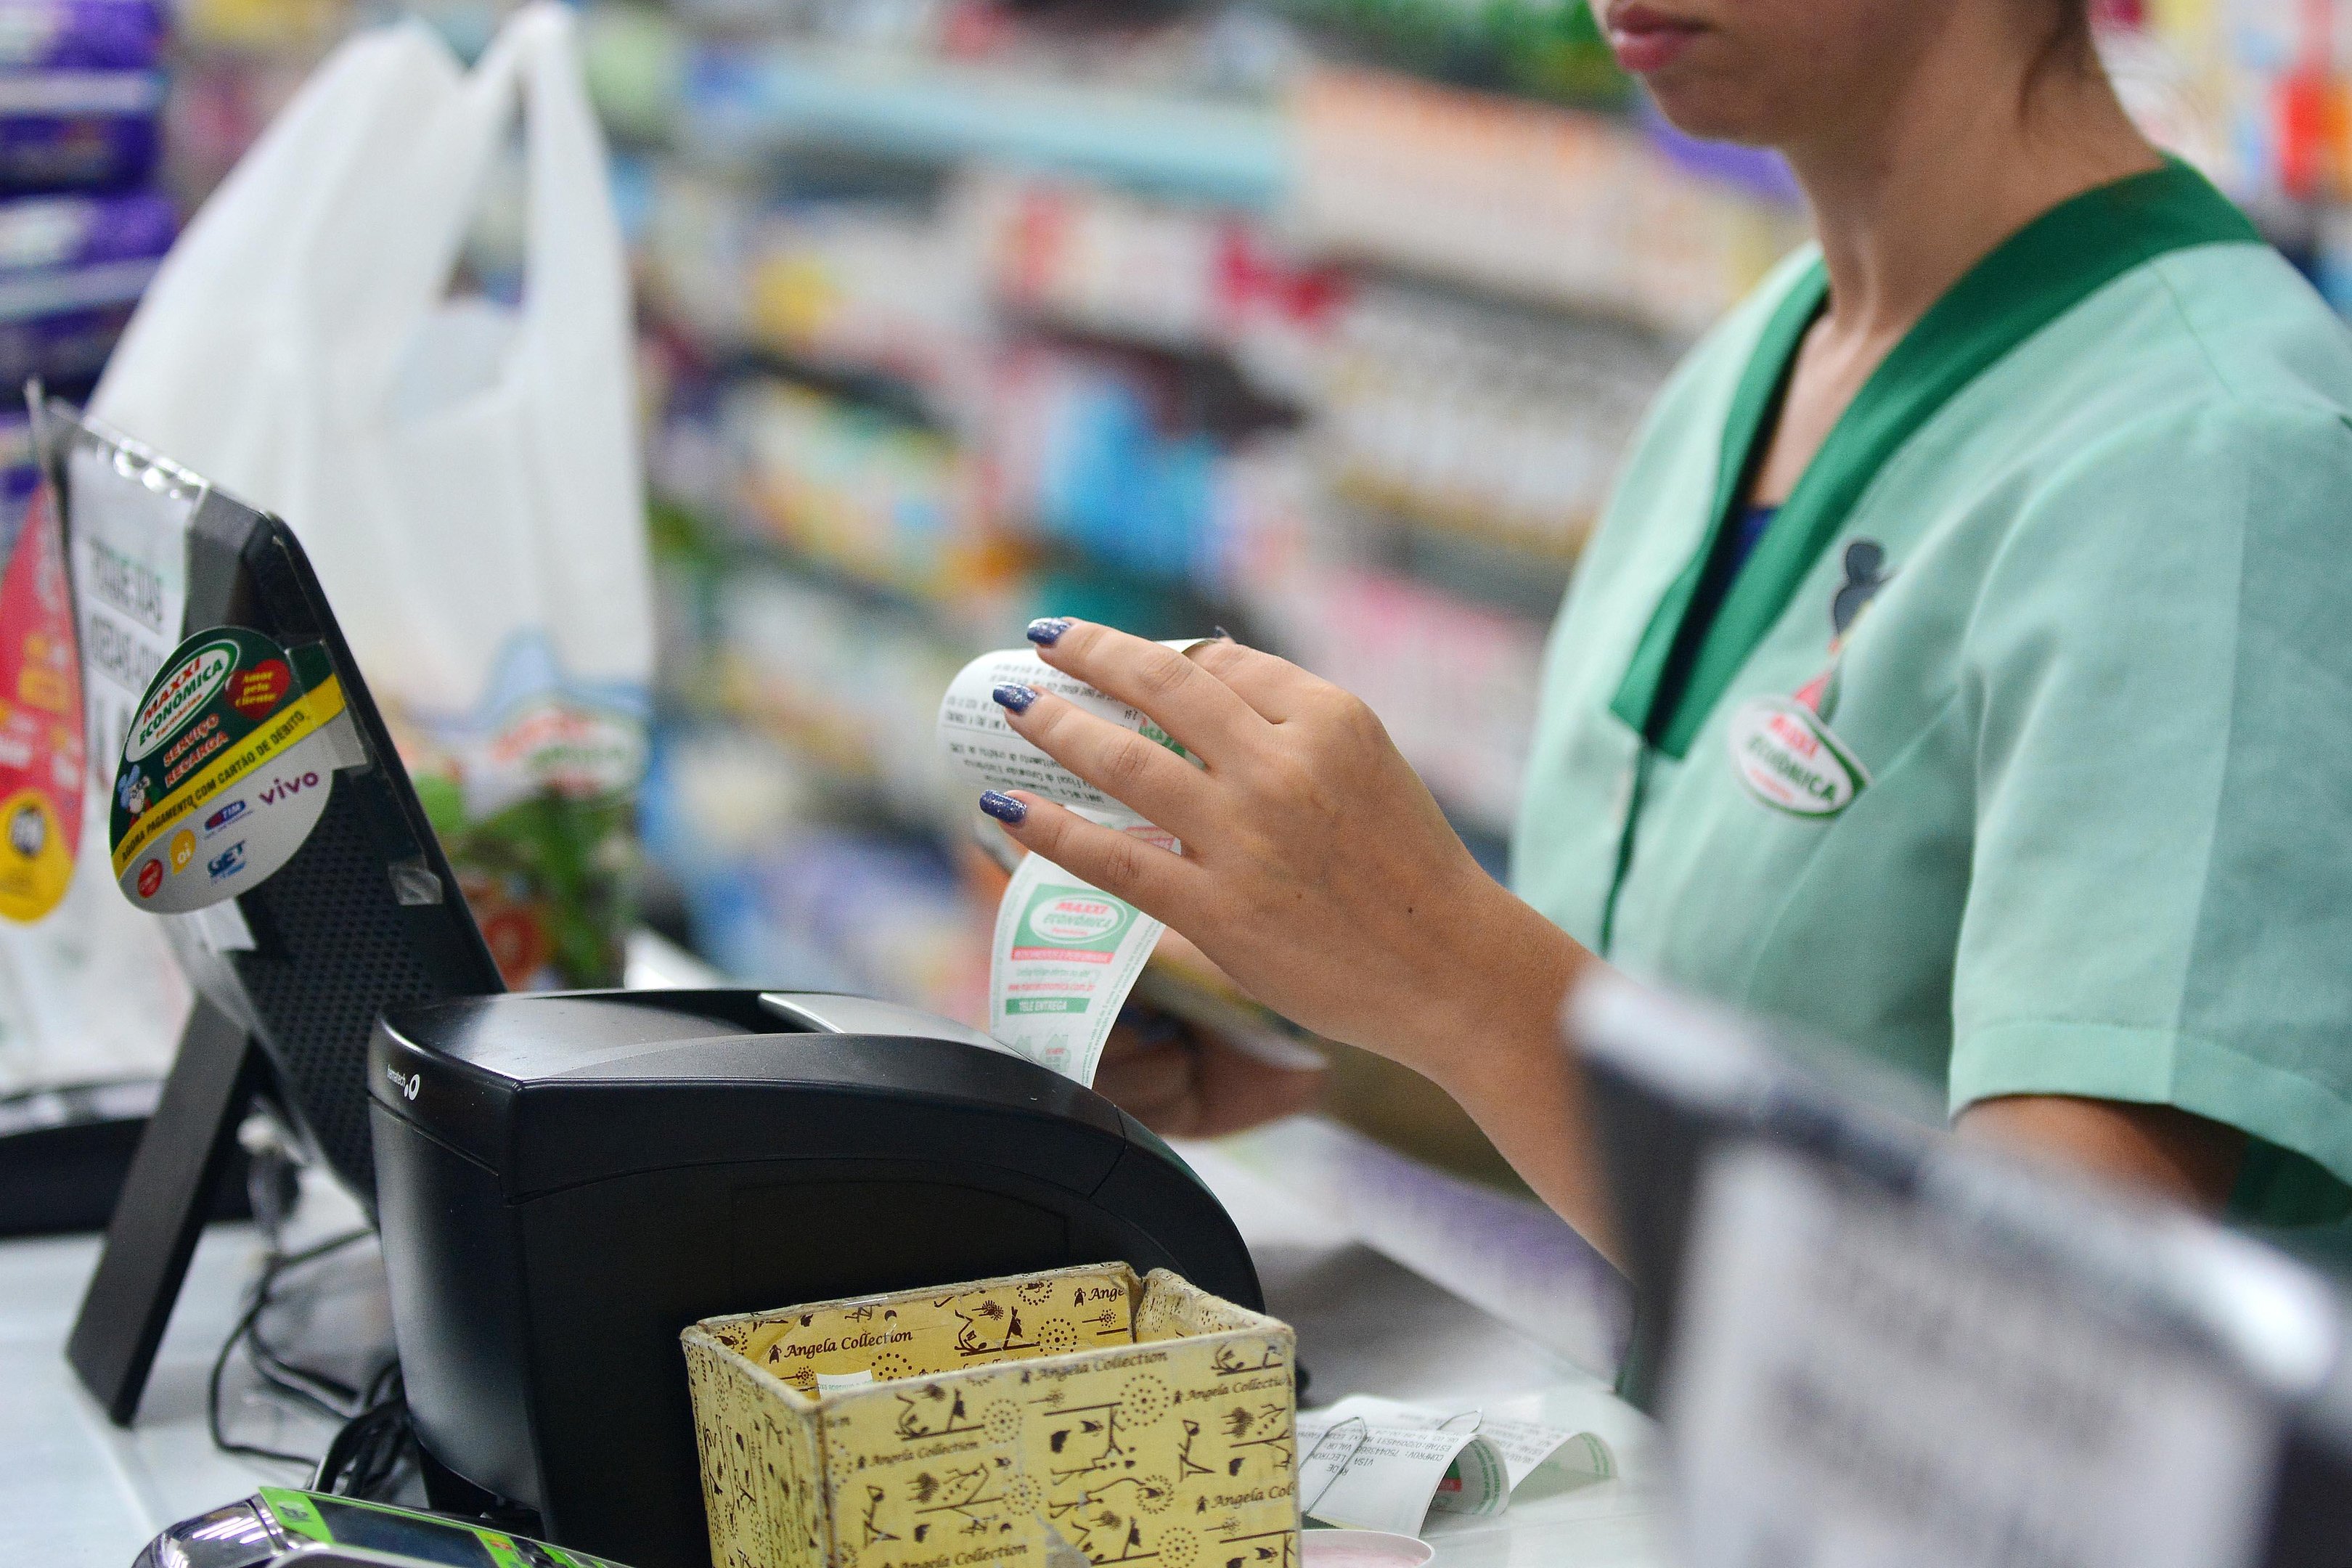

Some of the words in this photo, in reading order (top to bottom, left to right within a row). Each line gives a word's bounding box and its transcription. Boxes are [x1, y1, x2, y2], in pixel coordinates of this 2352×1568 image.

[144, 656, 201, 725] MAXXI
[139, 658, 223, 747] ECONÔMICA
[163, 713, 220, 767] SERVIÇO
[165, 731, 230, 788] RECARGA
[195, 779, 217, 803] COM
[218, 749, 256, 785] CARTÃO
[256, 738, 269, 756] DE
[258, 771, 319, 805] vivo
[1088, 1287, 1124, 1302] Ange
[784, 1338, 837, 1359] Angela
[841, 1331, 913, 1350] Collection
[1185, 1384, 1229, 1402] Angela
[870, 1449, 915, 1467] Angela
[917, 1442, 979, 1459] Collection
[1311, 1453, 1349, 1463] LECTRON
[1354, 1458, 1374, 1466] VISA
[1405, 1451, 1445, 1462] COMPROV:
[1327, 1463, 1349, 1476] RDE
[1212, 1487, 1265, 1508] Angela
[955, 1544, 1028, 1566] Collection
